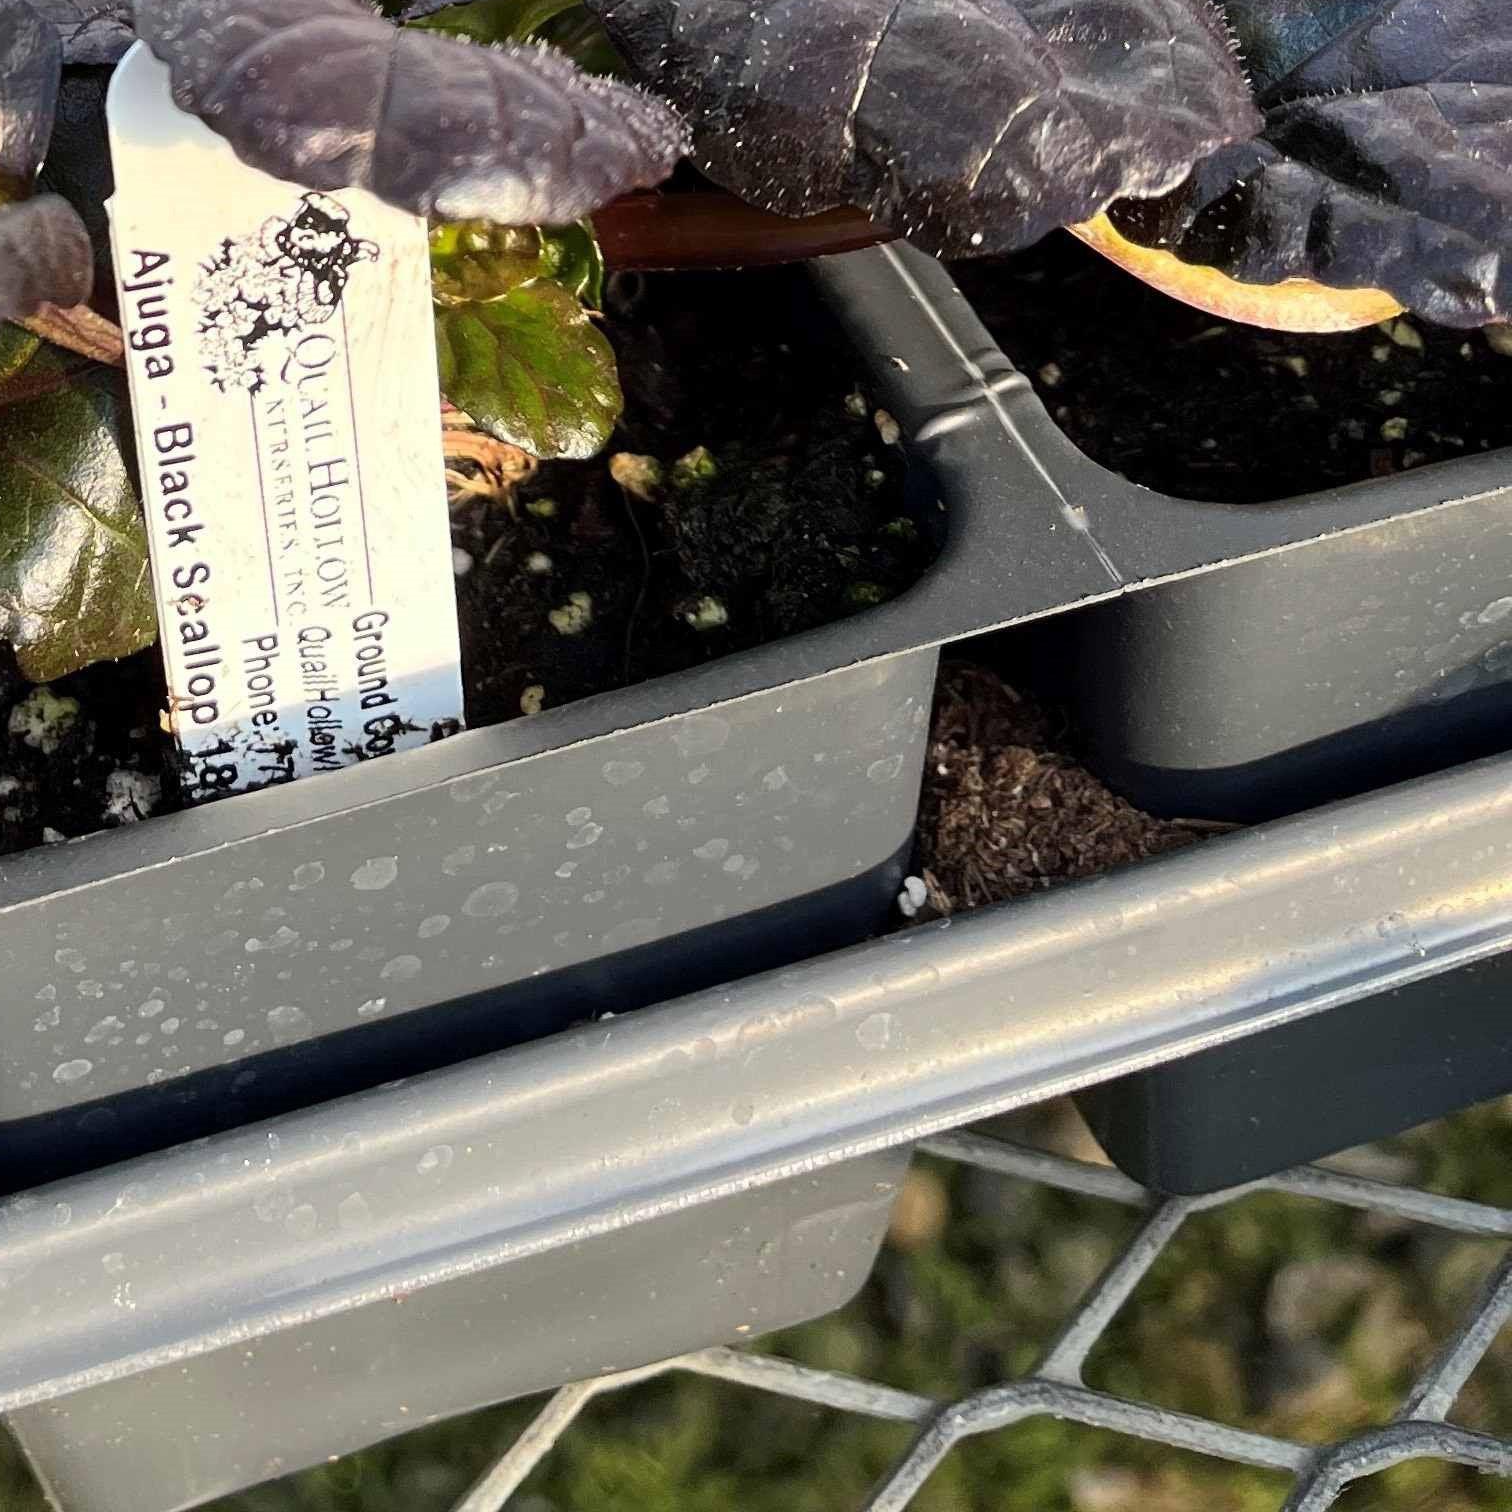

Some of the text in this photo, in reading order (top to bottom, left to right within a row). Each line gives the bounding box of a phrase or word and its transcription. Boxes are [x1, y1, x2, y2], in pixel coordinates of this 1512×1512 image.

[122, 250, 175, 380] Ajuga
[159, 395, 168, 410] -
[153, 422, 206, 548] Black
[307, 457, 352, 608] HOLLOW
[172, 561, 224, 725] Scallop
[241, 633, 280, 733] Phone:
[297, 625, 345, 772] QuailHollow
[352, 610, 399, 710] Ground
